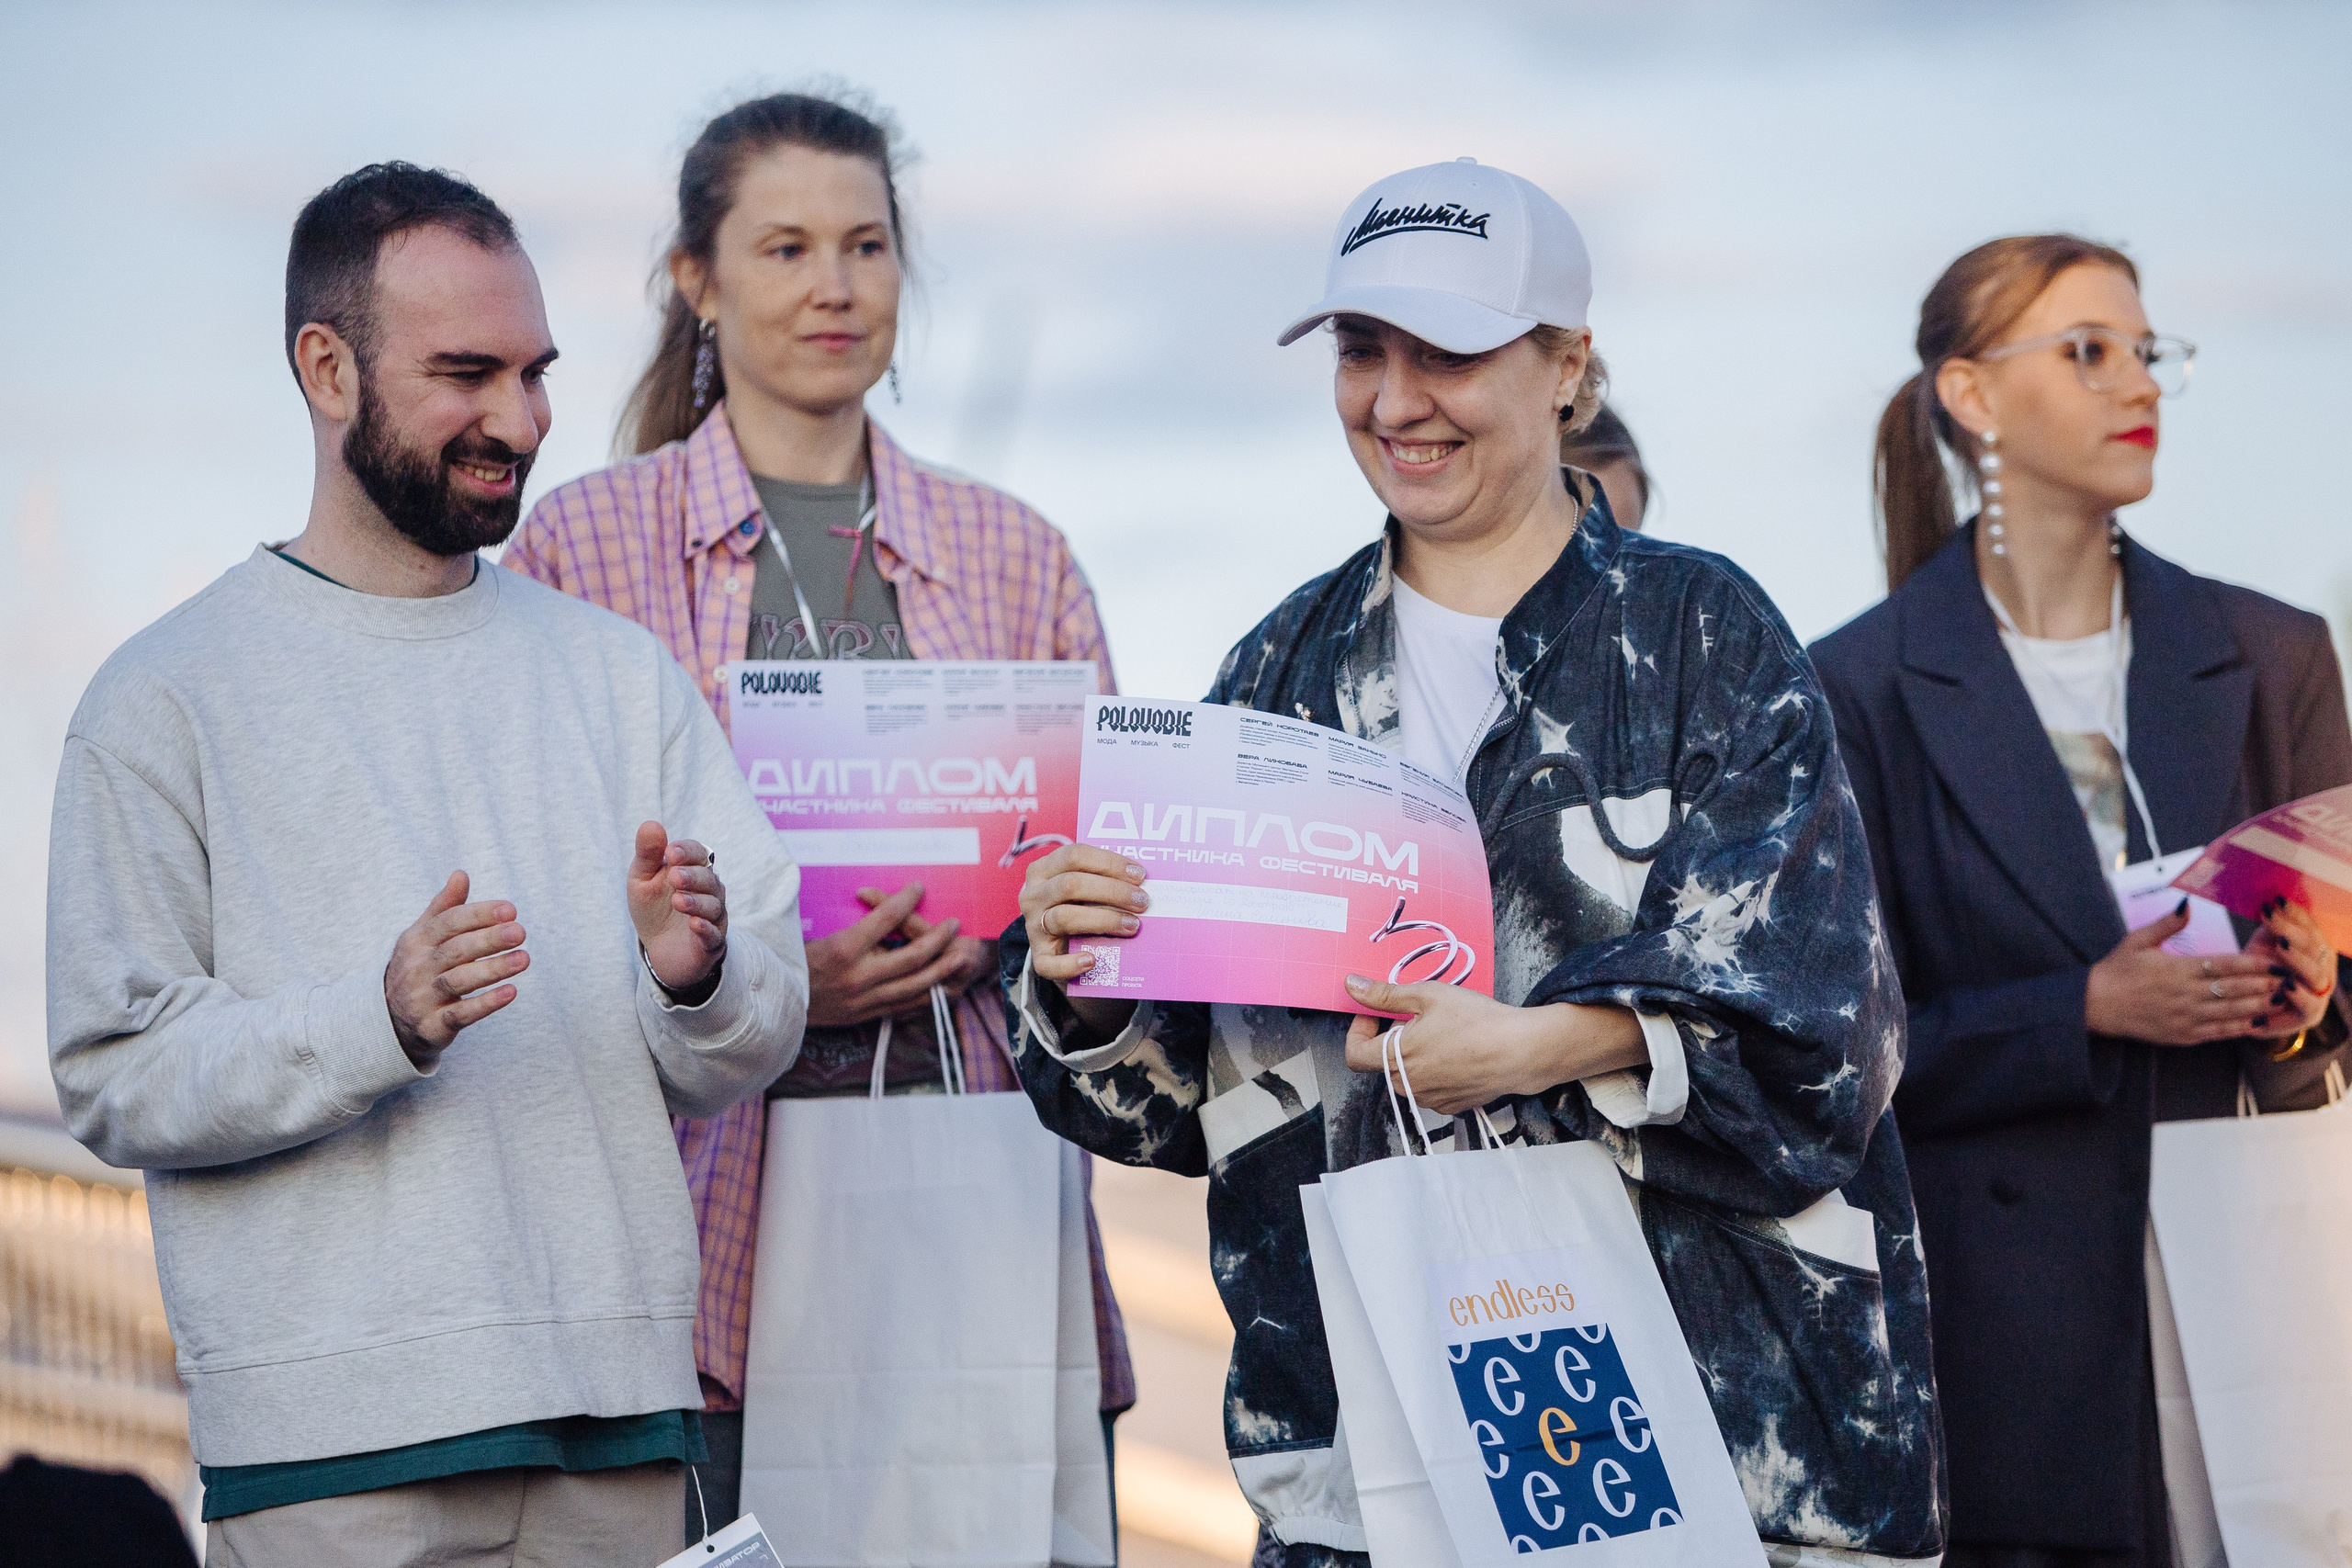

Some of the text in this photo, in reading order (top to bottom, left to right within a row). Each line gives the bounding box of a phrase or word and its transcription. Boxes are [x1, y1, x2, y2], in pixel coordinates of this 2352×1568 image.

[1096, 705, 1193, 737] POLOVODIE
[1240, 716, 1319, 737] СЕРГЕЙ КОРОТАЕВ
[748, 758, 1038, 796] ДИПЛОМ
[760, 797, 1039, 816] ЧАСТНИКА ФЕСТИВАЛЯ
[1087, 801, 1419, 876] ДИПЛОМ
[1100, 845, 1419, 894] ЧАСТНИКА ФЕСТИВАЛЯ
[1448, 1279, 1575, 1326] endless
[1484, 1357, 1525, 1416] e
[1555, 1346, 1596, 1403] e
[1470, 1419, 1510, 1479] e
[1538, 1407, 1580, 1466] e
[1610, 1396, 1652, 1453] e
[1522, 1471, 1565, 1530] e
[1592, 1458, 1635, 1517] e
